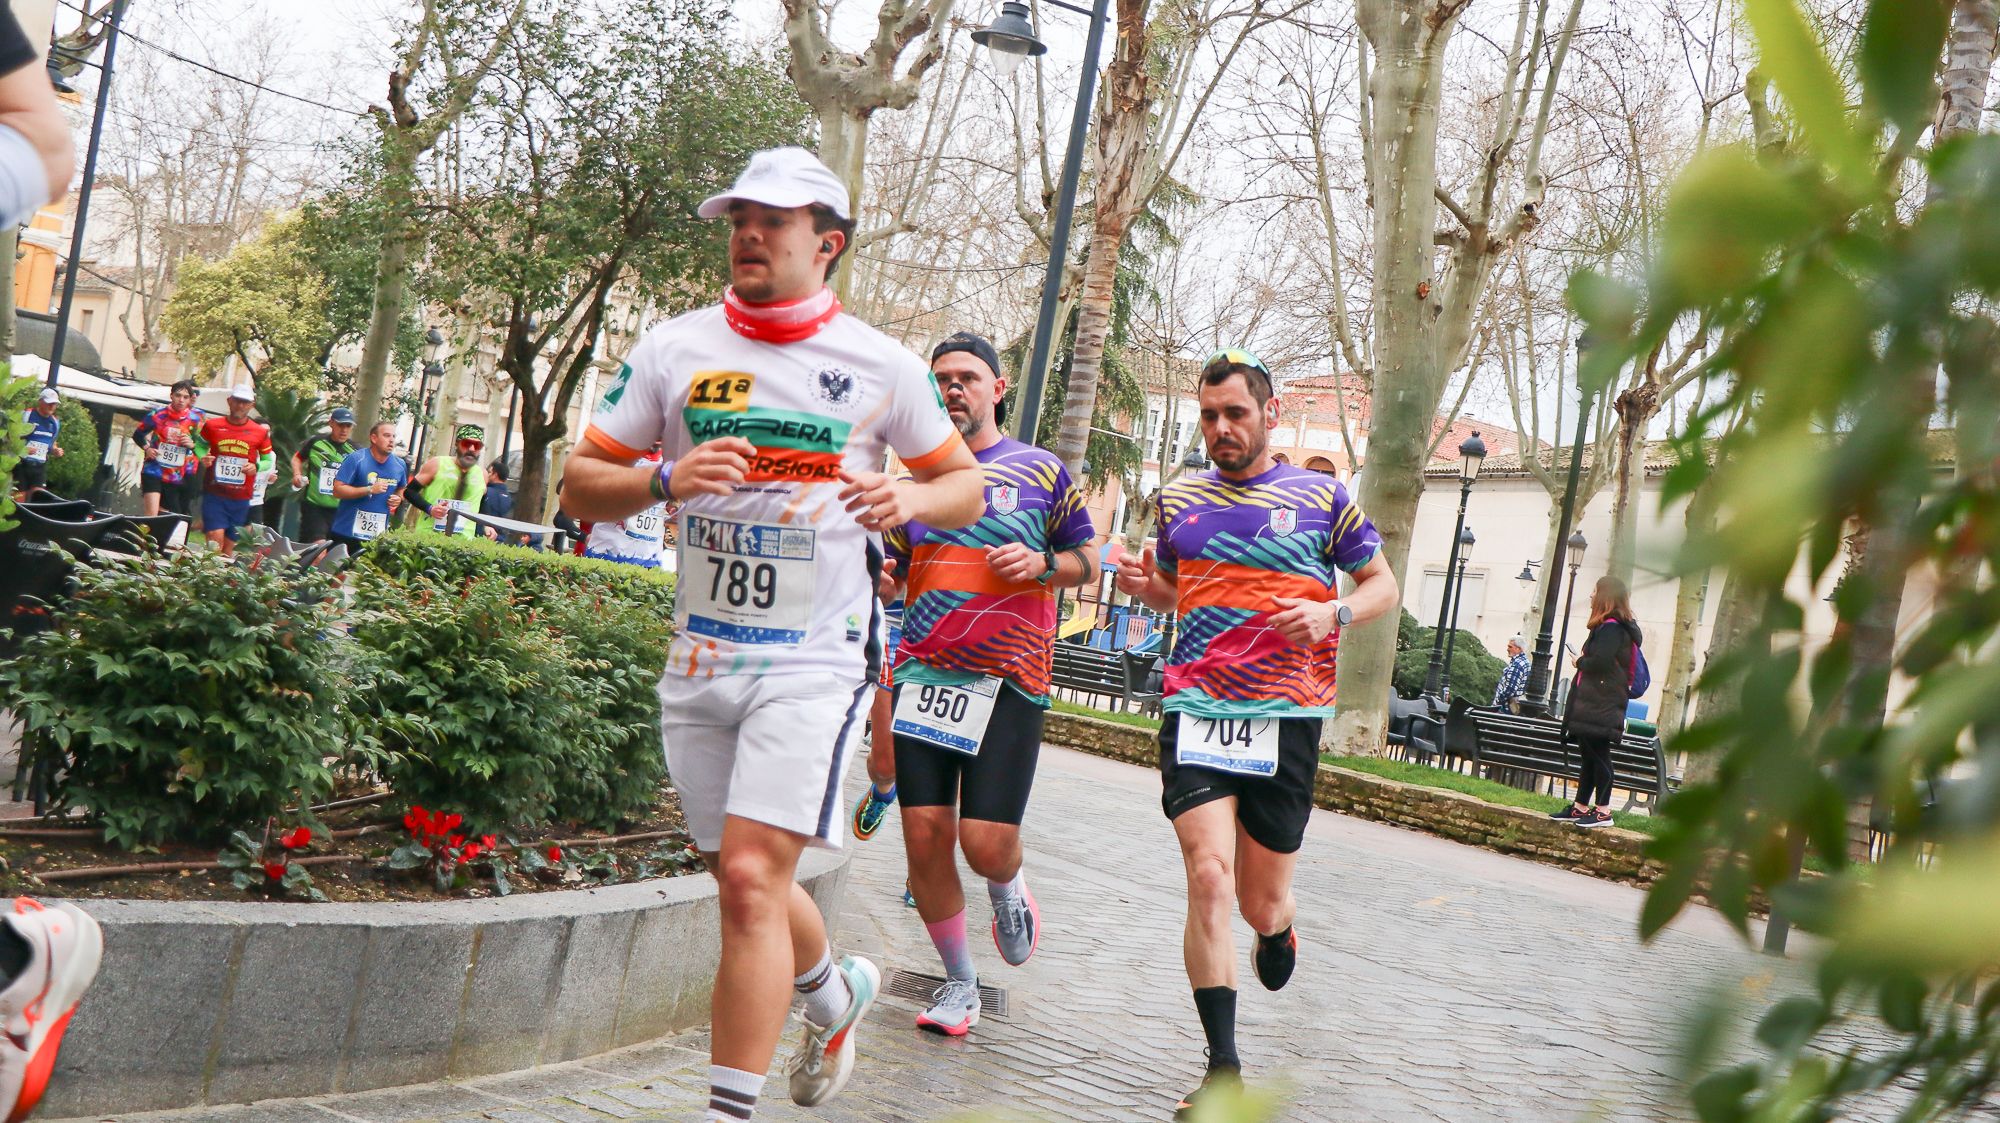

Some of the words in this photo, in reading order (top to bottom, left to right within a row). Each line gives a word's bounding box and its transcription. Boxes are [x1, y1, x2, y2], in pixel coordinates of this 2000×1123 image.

[693, 378, 751, 404] 11ª
[690, 417, 833, 446] CARRERA
[163, 451, 178, 462] 991
[221, 465, 242, 477] 1537
[636, 514, 658, 531] 507
[700, 519, 737, 553] 21K
[707, 555, 777, 610] 789
[917, 684, 969, 723] 950
[1202, 717, 1253, 748] 704
